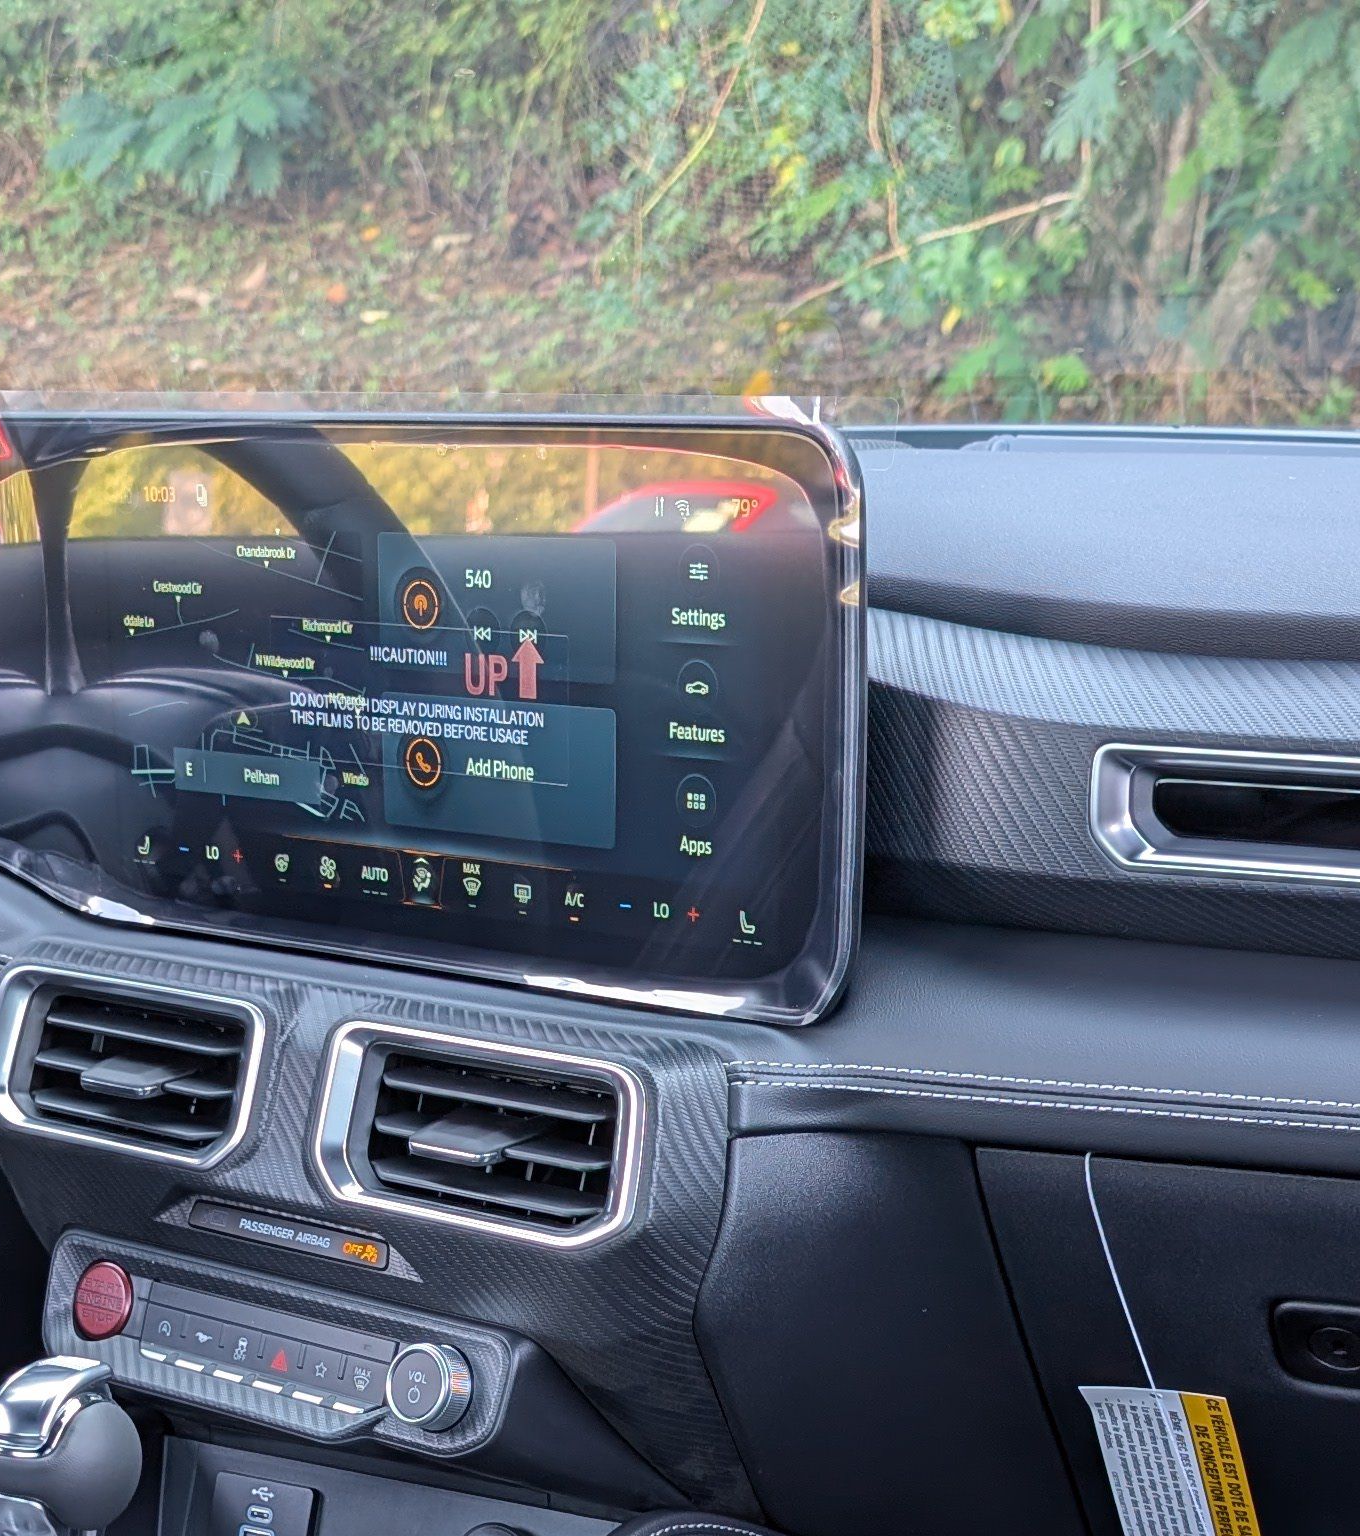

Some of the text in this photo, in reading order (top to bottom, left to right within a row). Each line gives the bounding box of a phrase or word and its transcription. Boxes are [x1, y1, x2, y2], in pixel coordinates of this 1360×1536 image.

[143, 486, 176, 503] 10:03
[236, 545, 296, 560] Chandabrook Dr
[153, 580, 203, 595] Crestwood Cir
[465, 569, 492, 589] 540
[144, 616, 155, 628] Ln
[302, 618, 354, 635] Richmond Cir
[671, 607, 726, 631] Settings
[255, 653, 316, 670] N Wildewood Dr
[370, 645, 448, 667] !!!CAUTION!!!
[464, 652, 508, 697] UP
[290, 691, 307, 707] DO
[307, 693, 331, 709] NOT
[371, 698, 416, 718] DISPLAY
[418, 701, 462, 721] DURING
[463, 704, 545, 728] INSTALLATION
[290, 710, 529, 746] THIS FILM IS TO BE REMOVED BEFORE USAGE
[668, 722, 726, 745] Features
[186, 761, 193, 777] E
[244, 767, 280, 787] Pelham
[465, 756, 534, 782] Add Phone
[205, 845, 219, 861] LO
[679, 834, 713, 857] Apps
[361, 865, 389, 882] AUTO
[462, 862, 480, 876] MAX
[564, 891, 585, 909] A/C
[653, 902, 670, 920] LO
[239, 1217, 331, 1249] PASSENGER AIRBAG
[342, 1241, 363, 1257] OFF
[83, 1276, 123, 1291] START
[79, 1292, 123, 1311] ENGINE
[82, 1308, 114, 1323] STOP
[354, 1367, 372, 1380] MAX
[407, 1369, 428, 1385] VOL
[1205, 1398, 1222, 1413] CE
[1193, 1424, 1211, 1440] DE
[1210, 1414, 1234, 1461] VÉHICULE
[1199, 1440, 1226, 1503] CONCEPTION
[1221, 1461, 1240, 1481] EST
[1227, 1482, 1250, 1508] DOTÉ
[1233, 1509, 1250, 1524] DE
